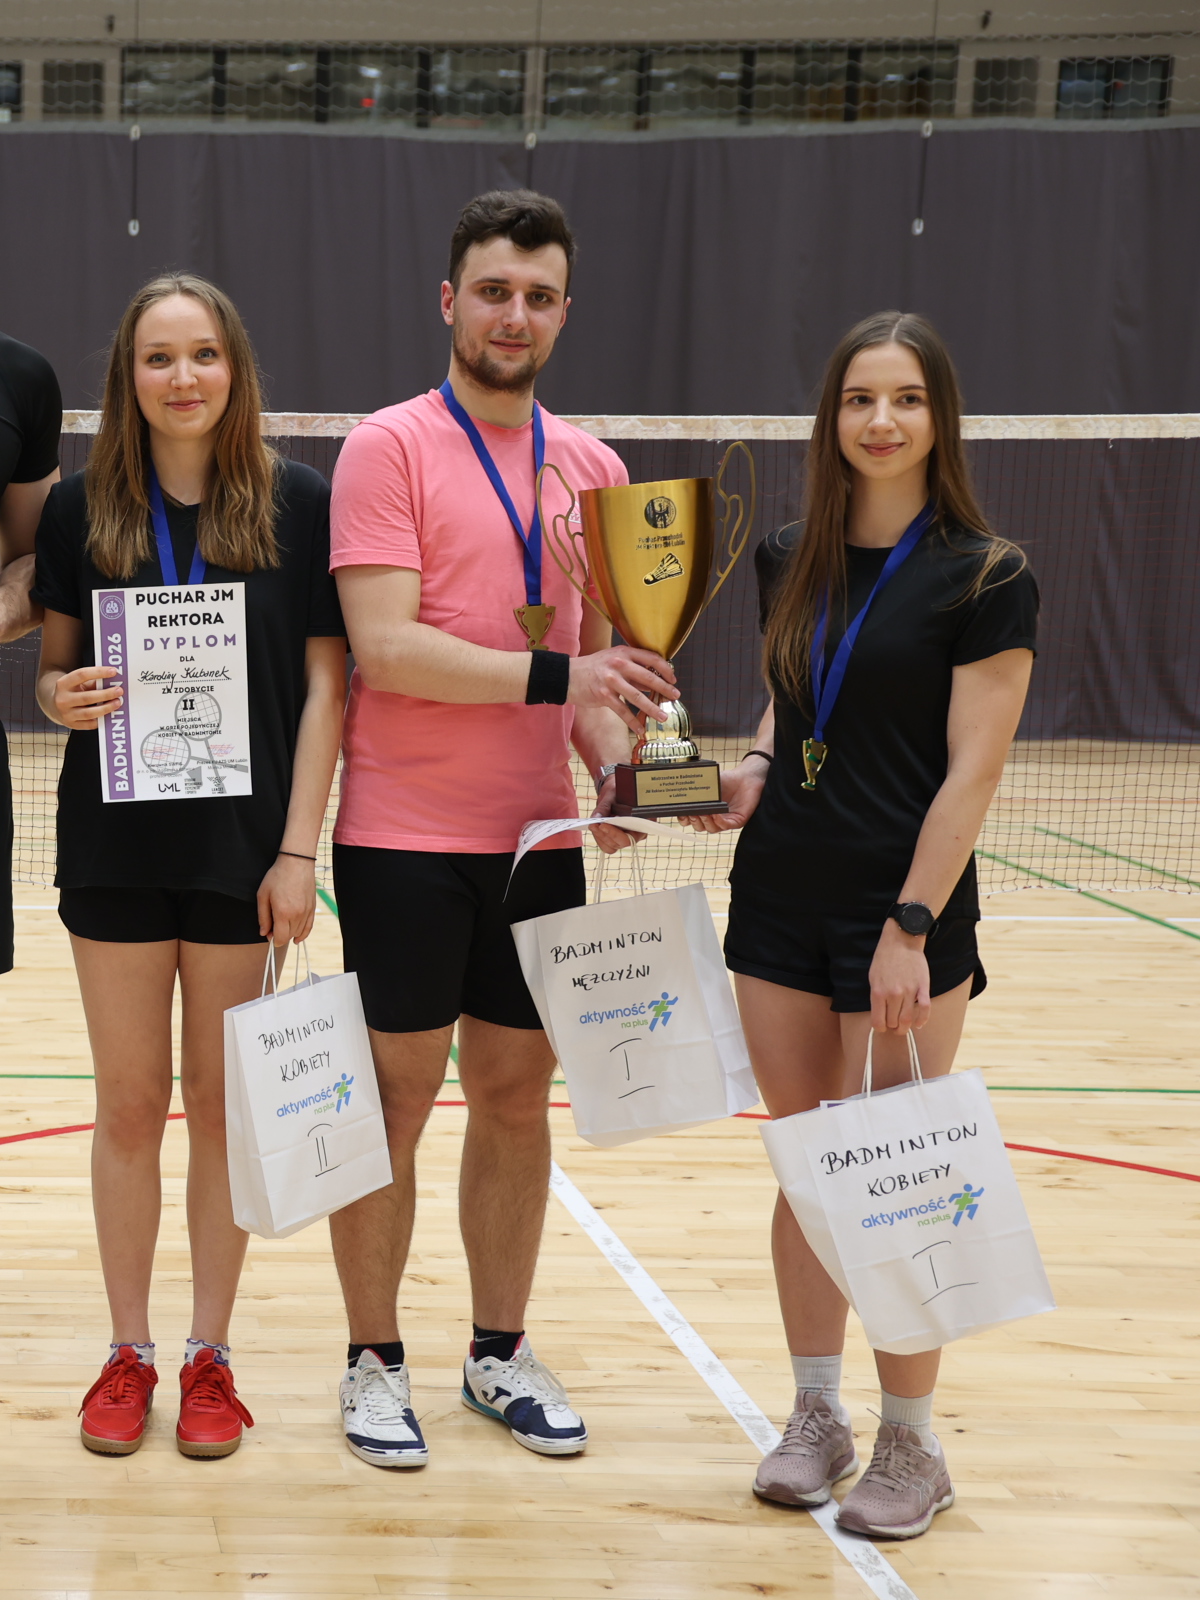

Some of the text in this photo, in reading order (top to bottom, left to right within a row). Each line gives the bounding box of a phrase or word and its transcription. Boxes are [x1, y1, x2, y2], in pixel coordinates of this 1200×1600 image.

[136, 589, 234, 605] PUCHAR JM
[148, 612, 224, 628] REKTORA
[144, 634, 237, 651] DYPLOM
[182, 699, 195, 710] II
[110, 681, 129, 791] BADMINTN
[551, 927, 662, 964] BADMINTON
[579, 1002, 646, 1024] aktywność
[621, 1018, 648, 1029] na plus
[258, 1015, 334, 1055] BADMINTON
[280, 1051, 330, 1082] KOBIETY
[276, 1087, 332, 1118] aktywność
[314, 1102, 335, 1115] na plus
[820, 1122, 977, 1175] BADMINTON
[868, 1164, 951, 1198] KOBIETY
[861, 1196, 947, 1229] aktywność
[918, 1213, 951, 1228] na plus
